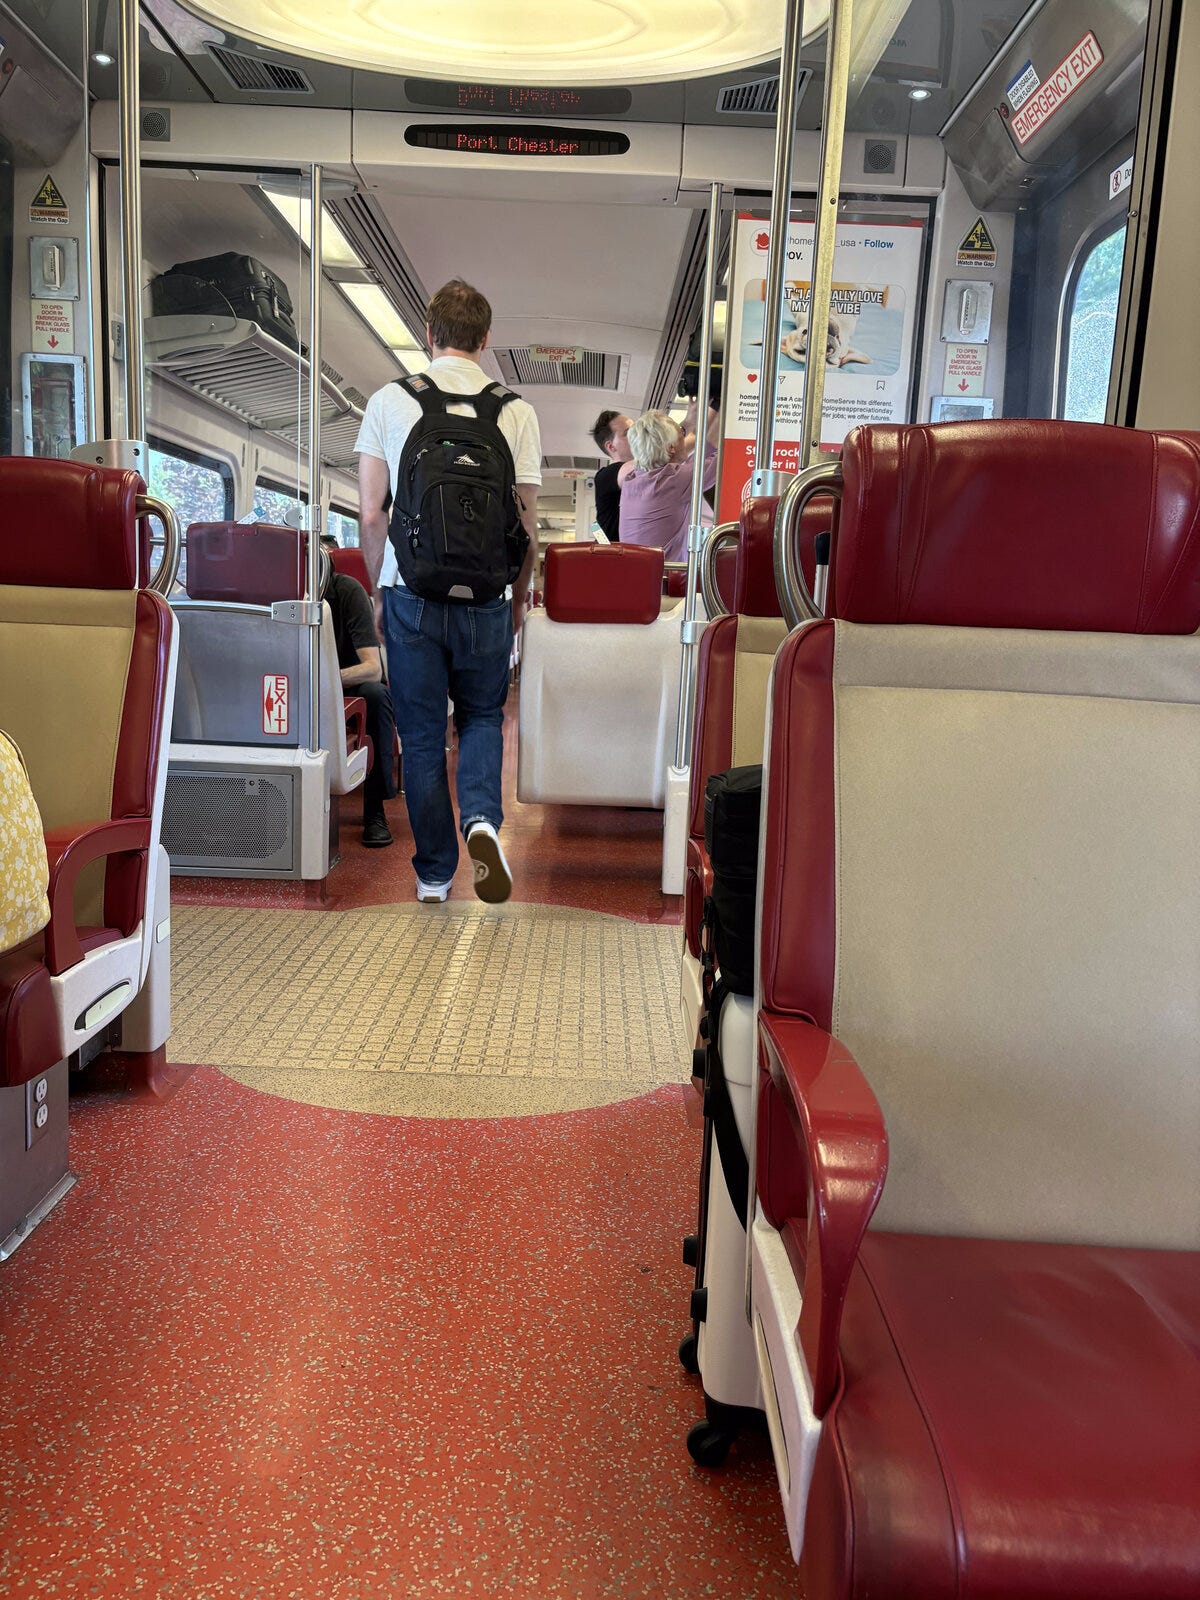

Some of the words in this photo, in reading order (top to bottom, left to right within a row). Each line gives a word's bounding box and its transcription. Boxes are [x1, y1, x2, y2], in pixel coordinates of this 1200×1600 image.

[1009, 85, 1021, 100] DOOR
[1014, 65, 1072, 140] EMERGENCY
[1069, 38, 1097, 80] EXIT
[457, 134, 498, 150] Port
[508, 137, 580, 154] Chester
[864, 239, 894, 249] Follow
[787, 251, 803, 260] OV.
[858, 291, 884, 303] LOVE
[791, 301, 809, 312] MY
[836, 303, 860, 314] VIBE
[536, 347, 576, 355] EMERGENCY
[776, 448, 799, 457] rock
[785, 459, 796, 469] in
[274, 677, 286, 732] EXIT
